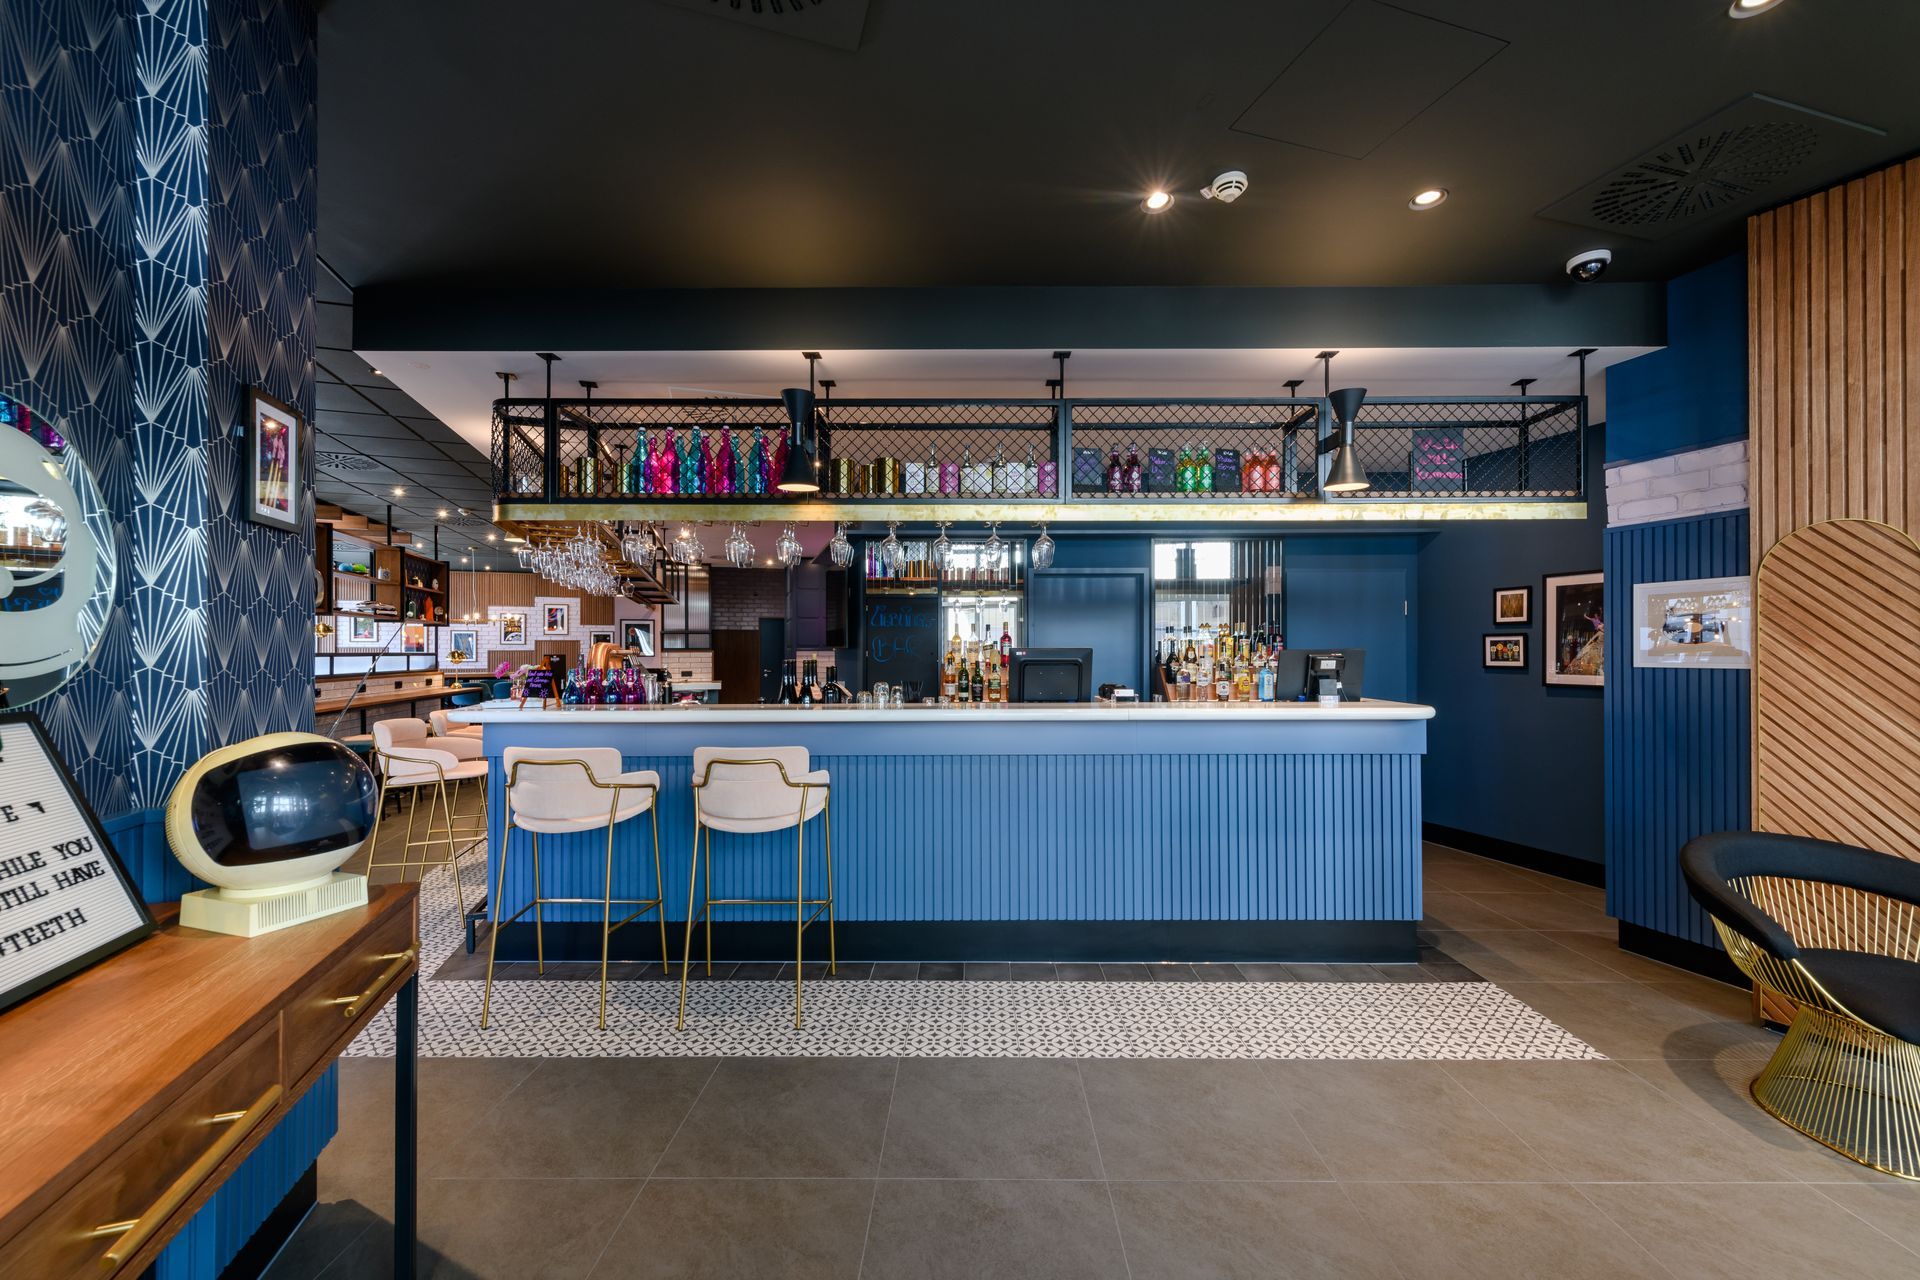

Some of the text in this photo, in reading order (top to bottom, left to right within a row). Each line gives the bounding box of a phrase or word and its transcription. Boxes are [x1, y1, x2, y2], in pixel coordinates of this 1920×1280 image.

[0, 836, 94, 880] HILE YOU
[0, 860, 105, 911] TILL HAVE
